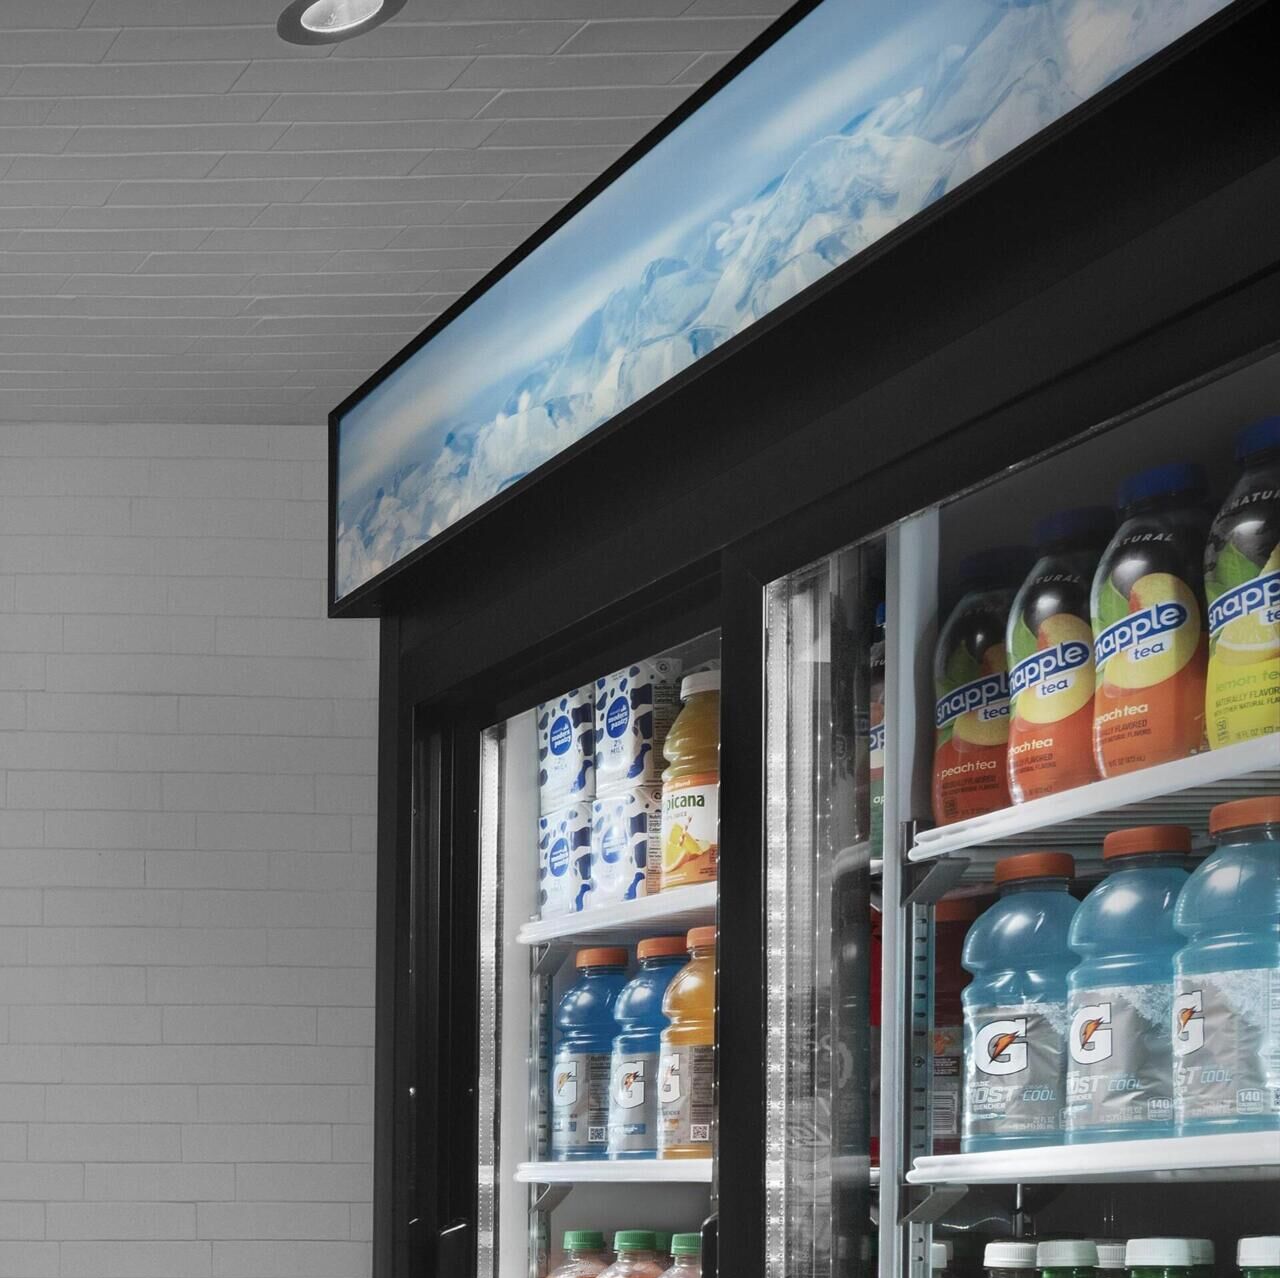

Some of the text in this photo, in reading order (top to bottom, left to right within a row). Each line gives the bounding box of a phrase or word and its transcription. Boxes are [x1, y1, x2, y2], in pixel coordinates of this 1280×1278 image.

[1134, 641, 1165, 661] tea
[1041, 677, 1069, 696] tea
[1124, 703, 1149, 717] tea
[1032, 735, 1053, 749] tea
[941, 759, 997, 779] peach tea
[1070, 1002, 1113, 1065] G
[975, 1017, 1028, 1077] G
[1201, 1069, 1233, 1084] COOL
[1023, 1087, 1057, 1102] COOL
[1240, 1091, 1260, 1102] 140
[1151, 1099, 1170, 1109] 140
